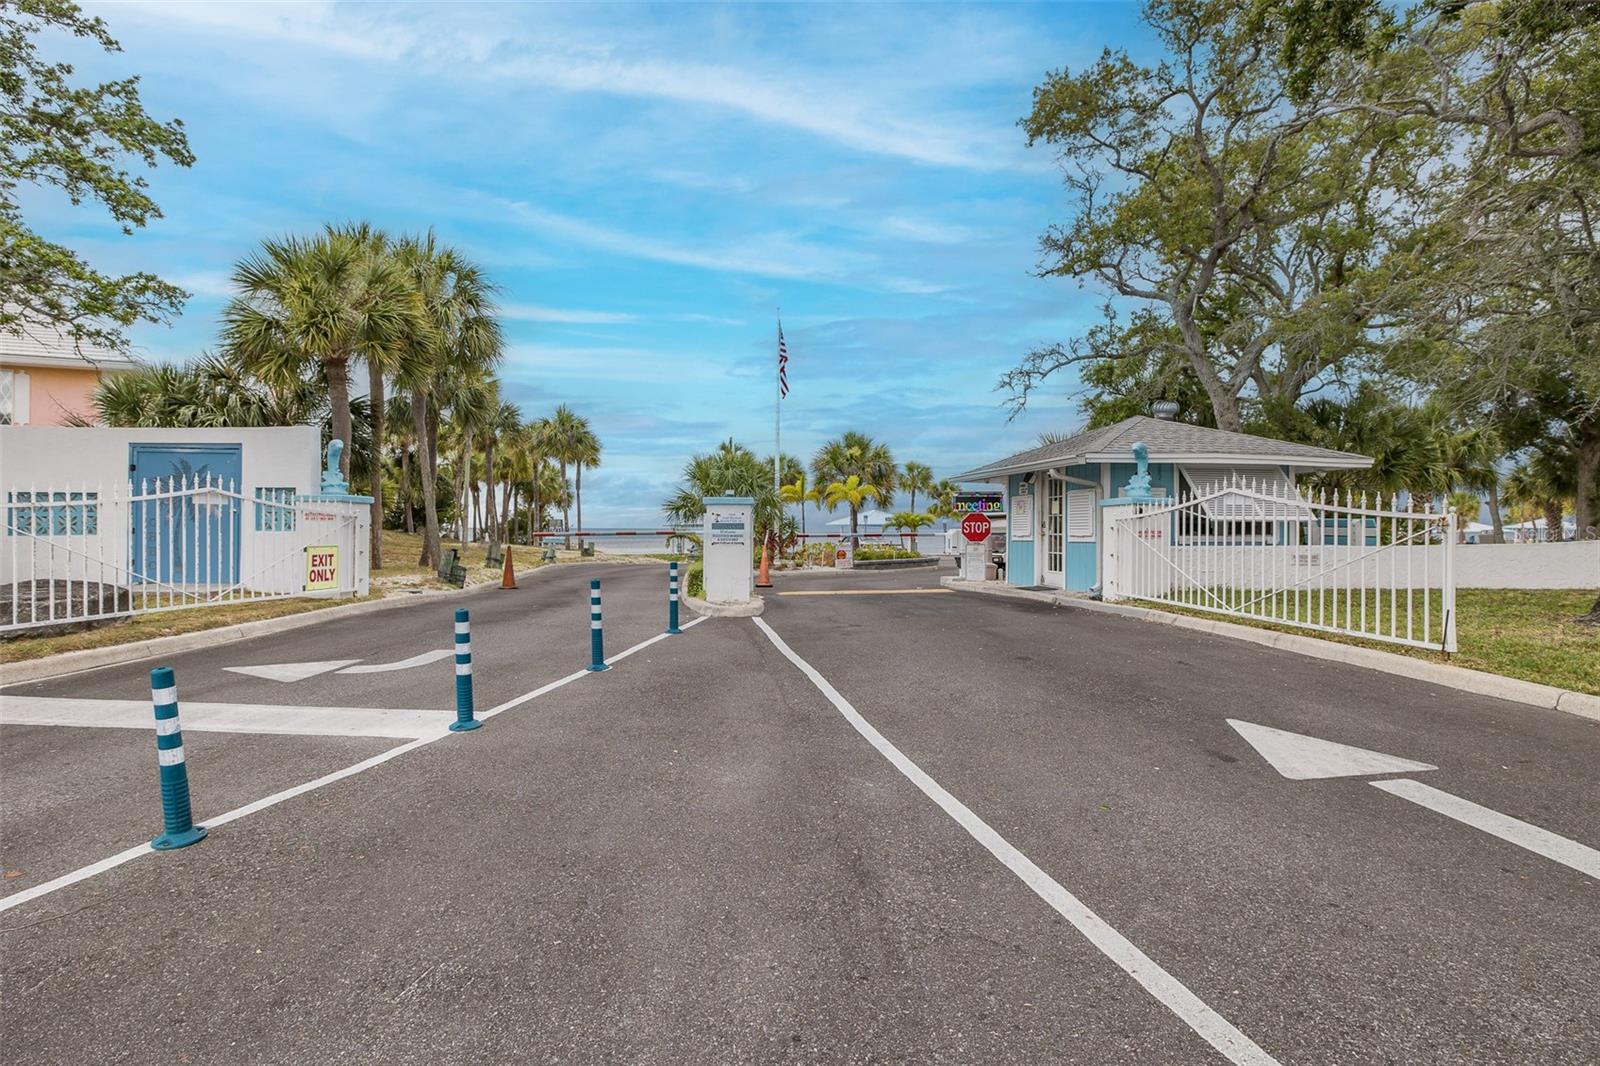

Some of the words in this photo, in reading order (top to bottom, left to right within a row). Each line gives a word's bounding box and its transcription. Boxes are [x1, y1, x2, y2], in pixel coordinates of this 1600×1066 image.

[953, 498, 1001, 512] meeting
[963, 521, 990, 534] STOP
[311, 554, 334, 567] EXIT
[309, 568, 336, 583] ONLY
